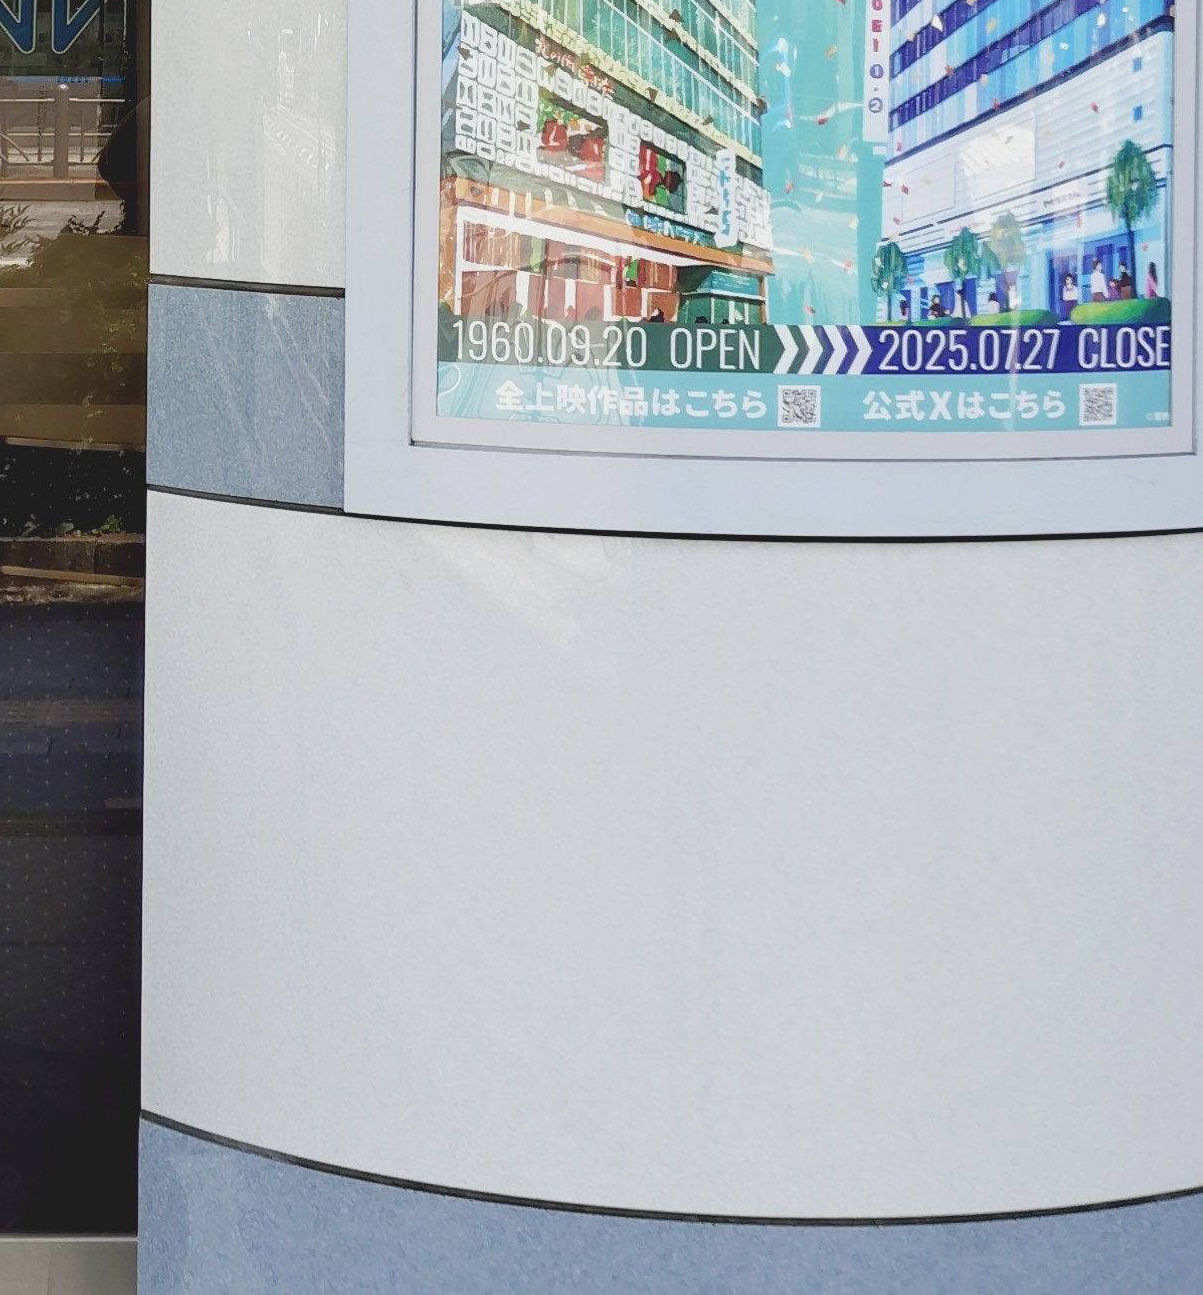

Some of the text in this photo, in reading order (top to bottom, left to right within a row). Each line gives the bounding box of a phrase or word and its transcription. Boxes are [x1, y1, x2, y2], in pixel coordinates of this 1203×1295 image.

[452, 318, 647, 369] 1960.09.20
[670, 327, 761, 370] OPEN
[1078, 325, 1170, 369] CLOSE
[495, 379, 768, 420] 全上映作品はこちら
[862, 390, 1067, 422] 公式Xはこちら
